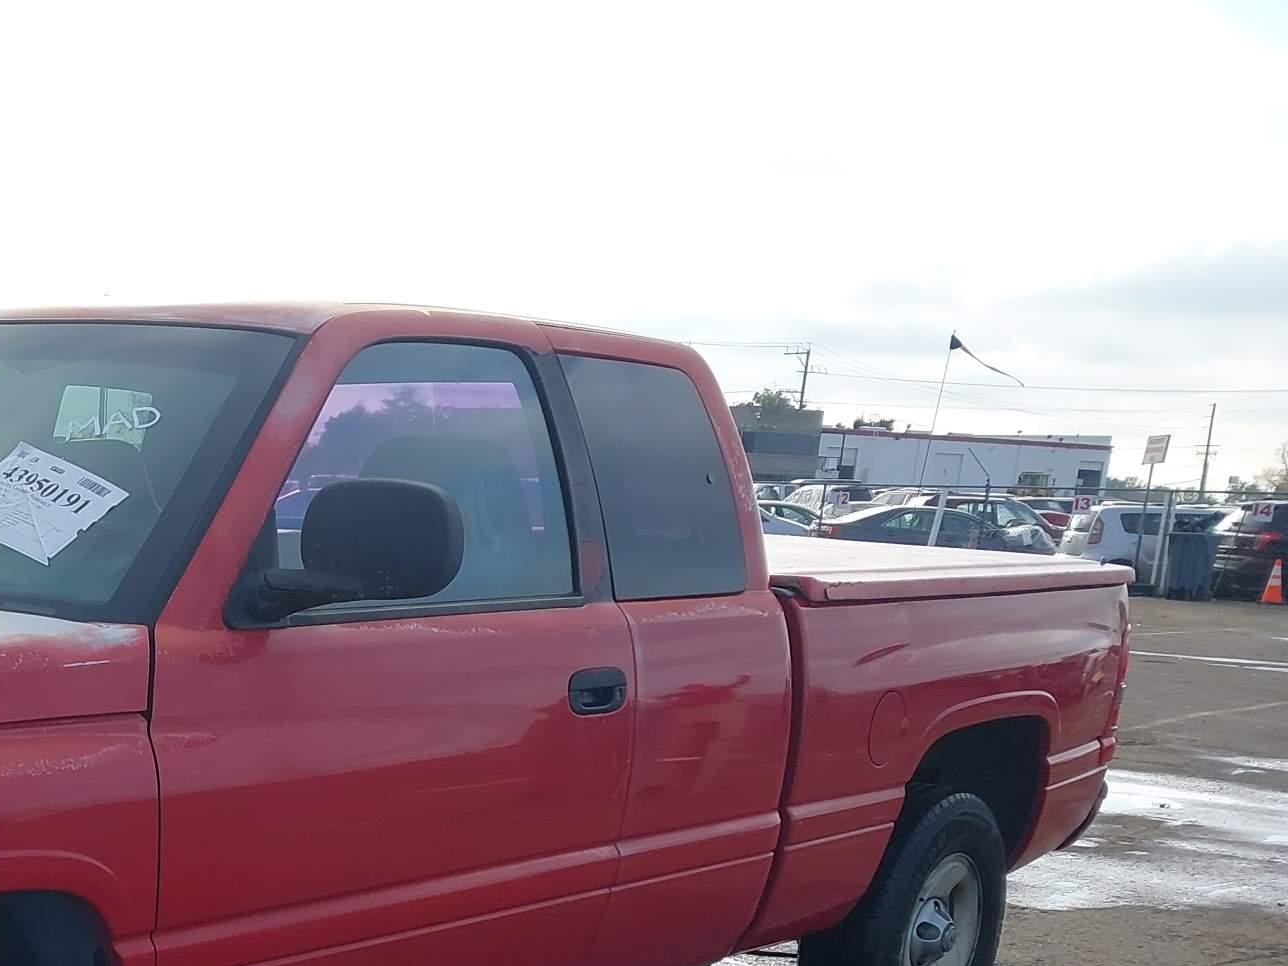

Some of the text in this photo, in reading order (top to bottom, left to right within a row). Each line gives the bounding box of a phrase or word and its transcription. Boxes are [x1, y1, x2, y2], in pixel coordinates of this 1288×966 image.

[65, 406, 161, 442] MAD
[2, 466, 92, 514] 43950191
[1074, 497, 1091, 511] 13
[1253, 503, 1273, 517] 14
